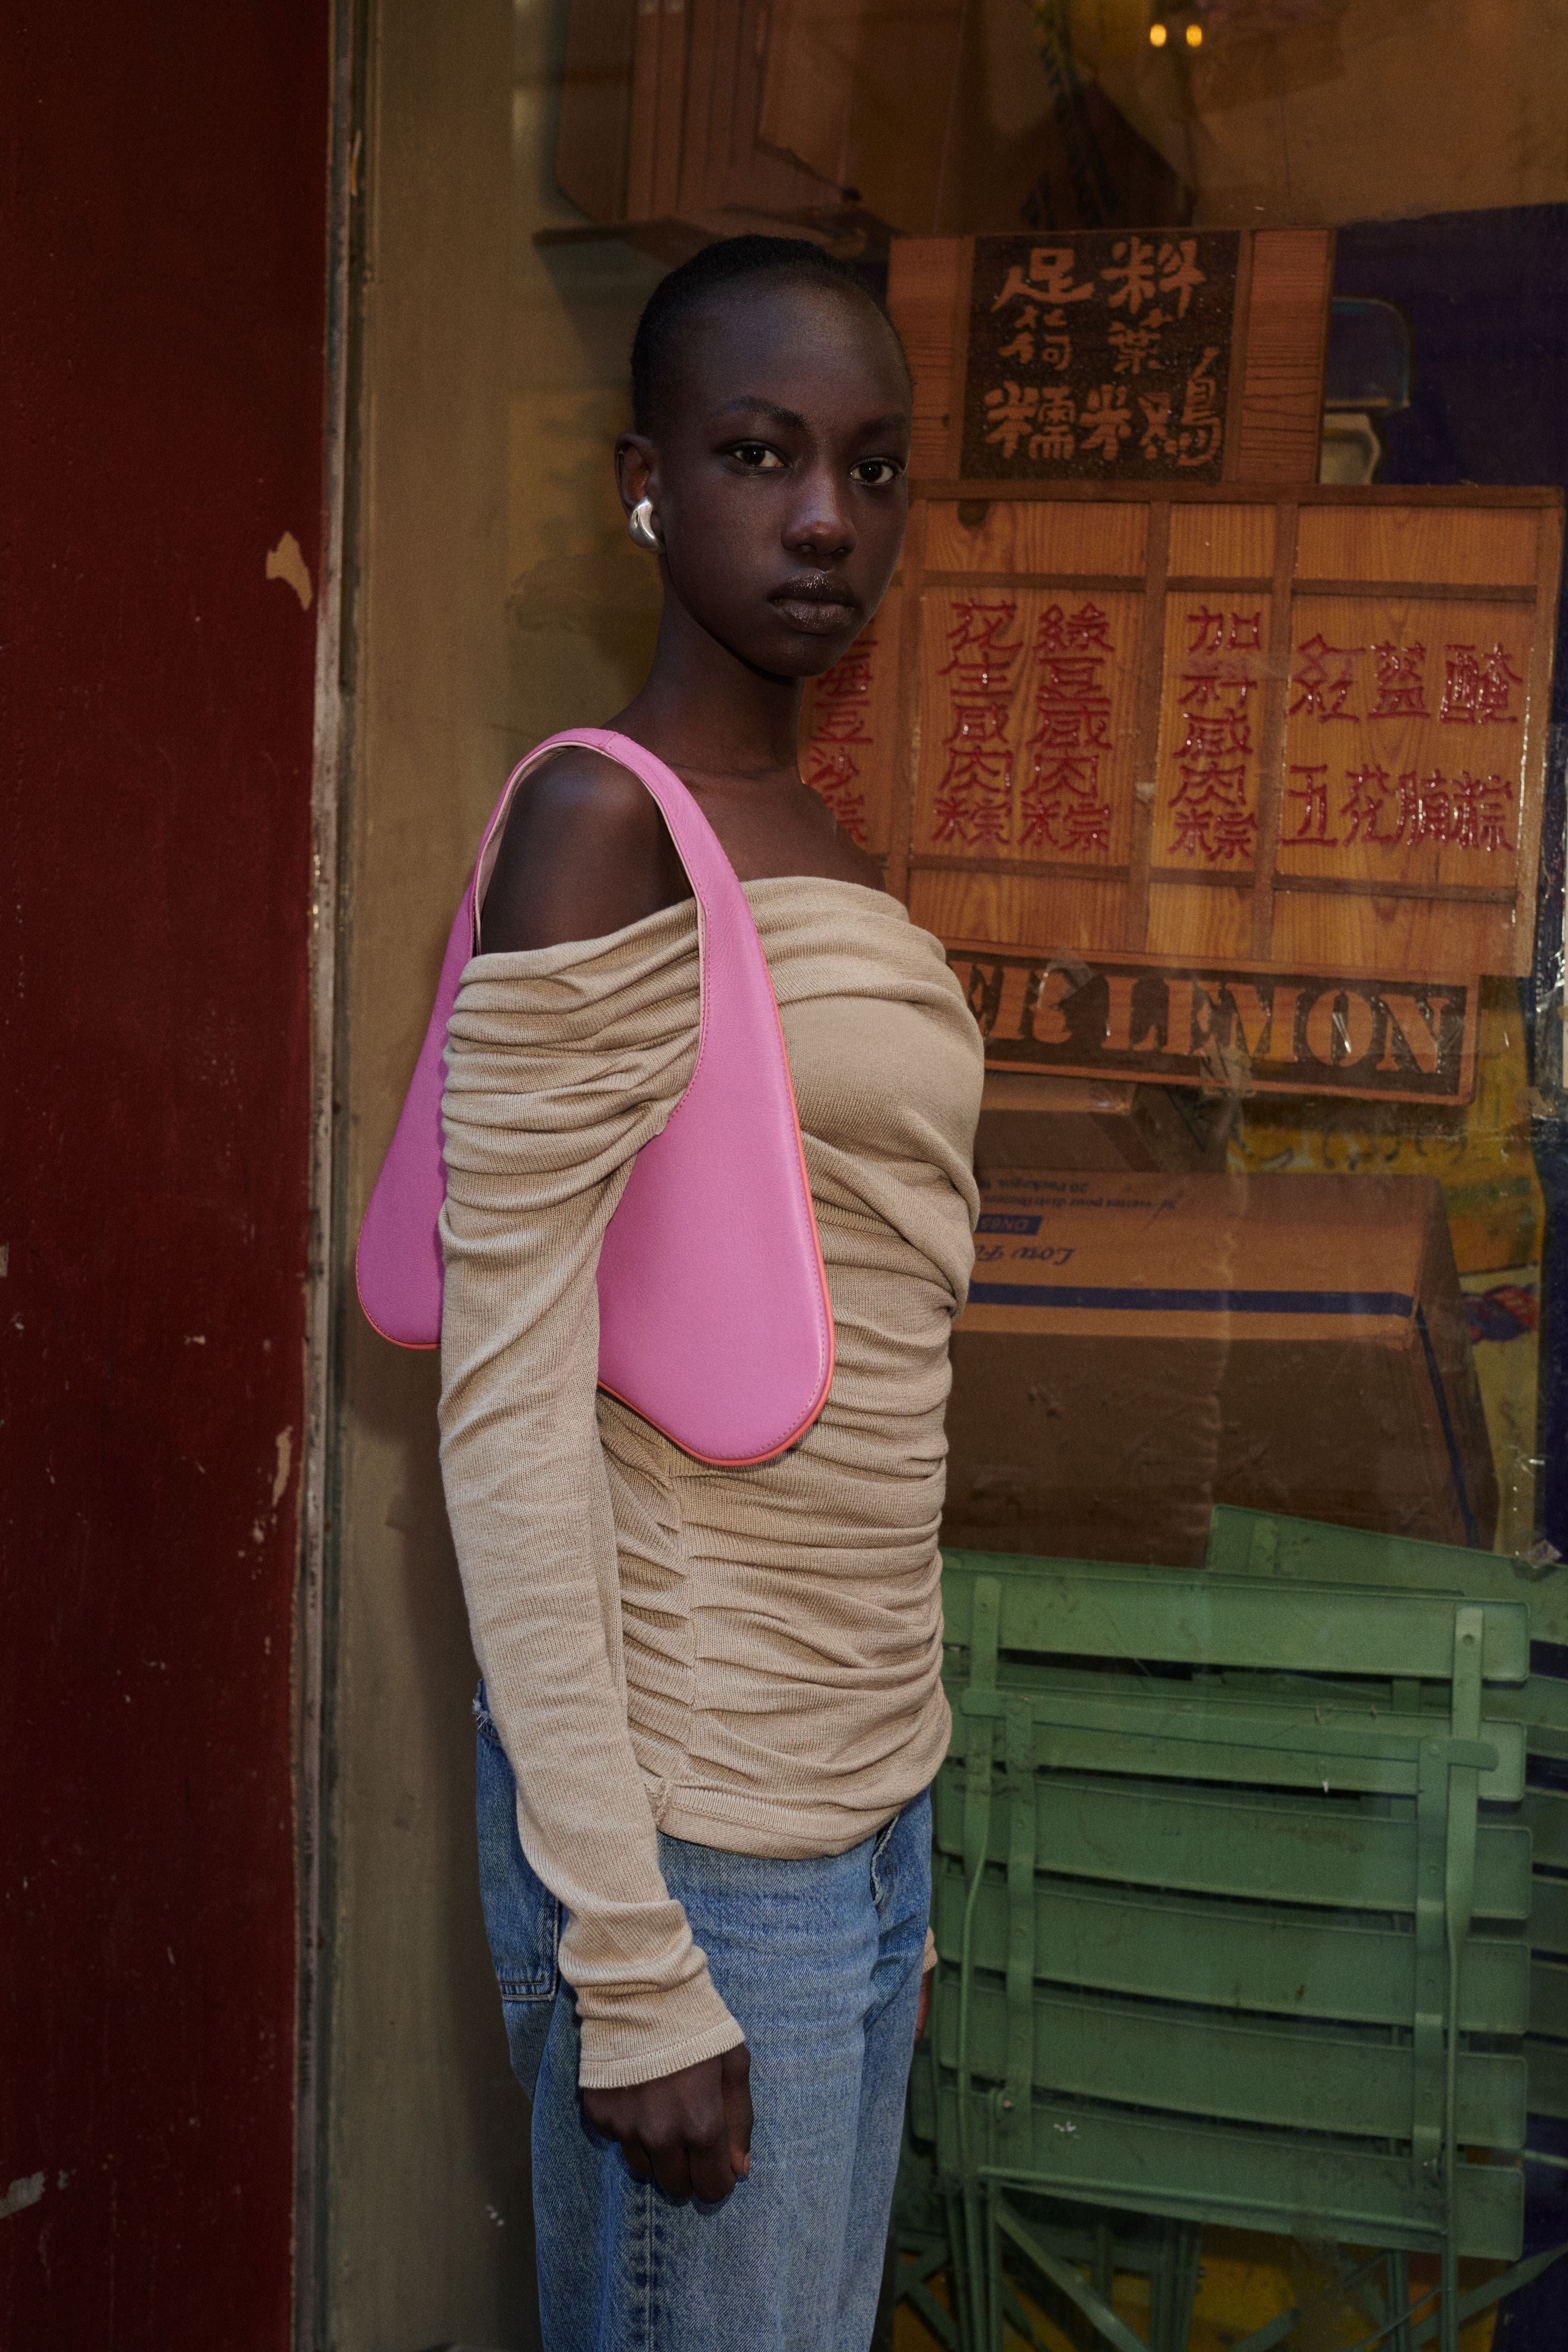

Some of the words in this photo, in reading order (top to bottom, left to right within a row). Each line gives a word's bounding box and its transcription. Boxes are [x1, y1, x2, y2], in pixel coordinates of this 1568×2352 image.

[991, 235, 1206, 319] 足料
[1100, 974, 1451, 1075] LEMON
[1010, 1246, 1076, 1266] Low
